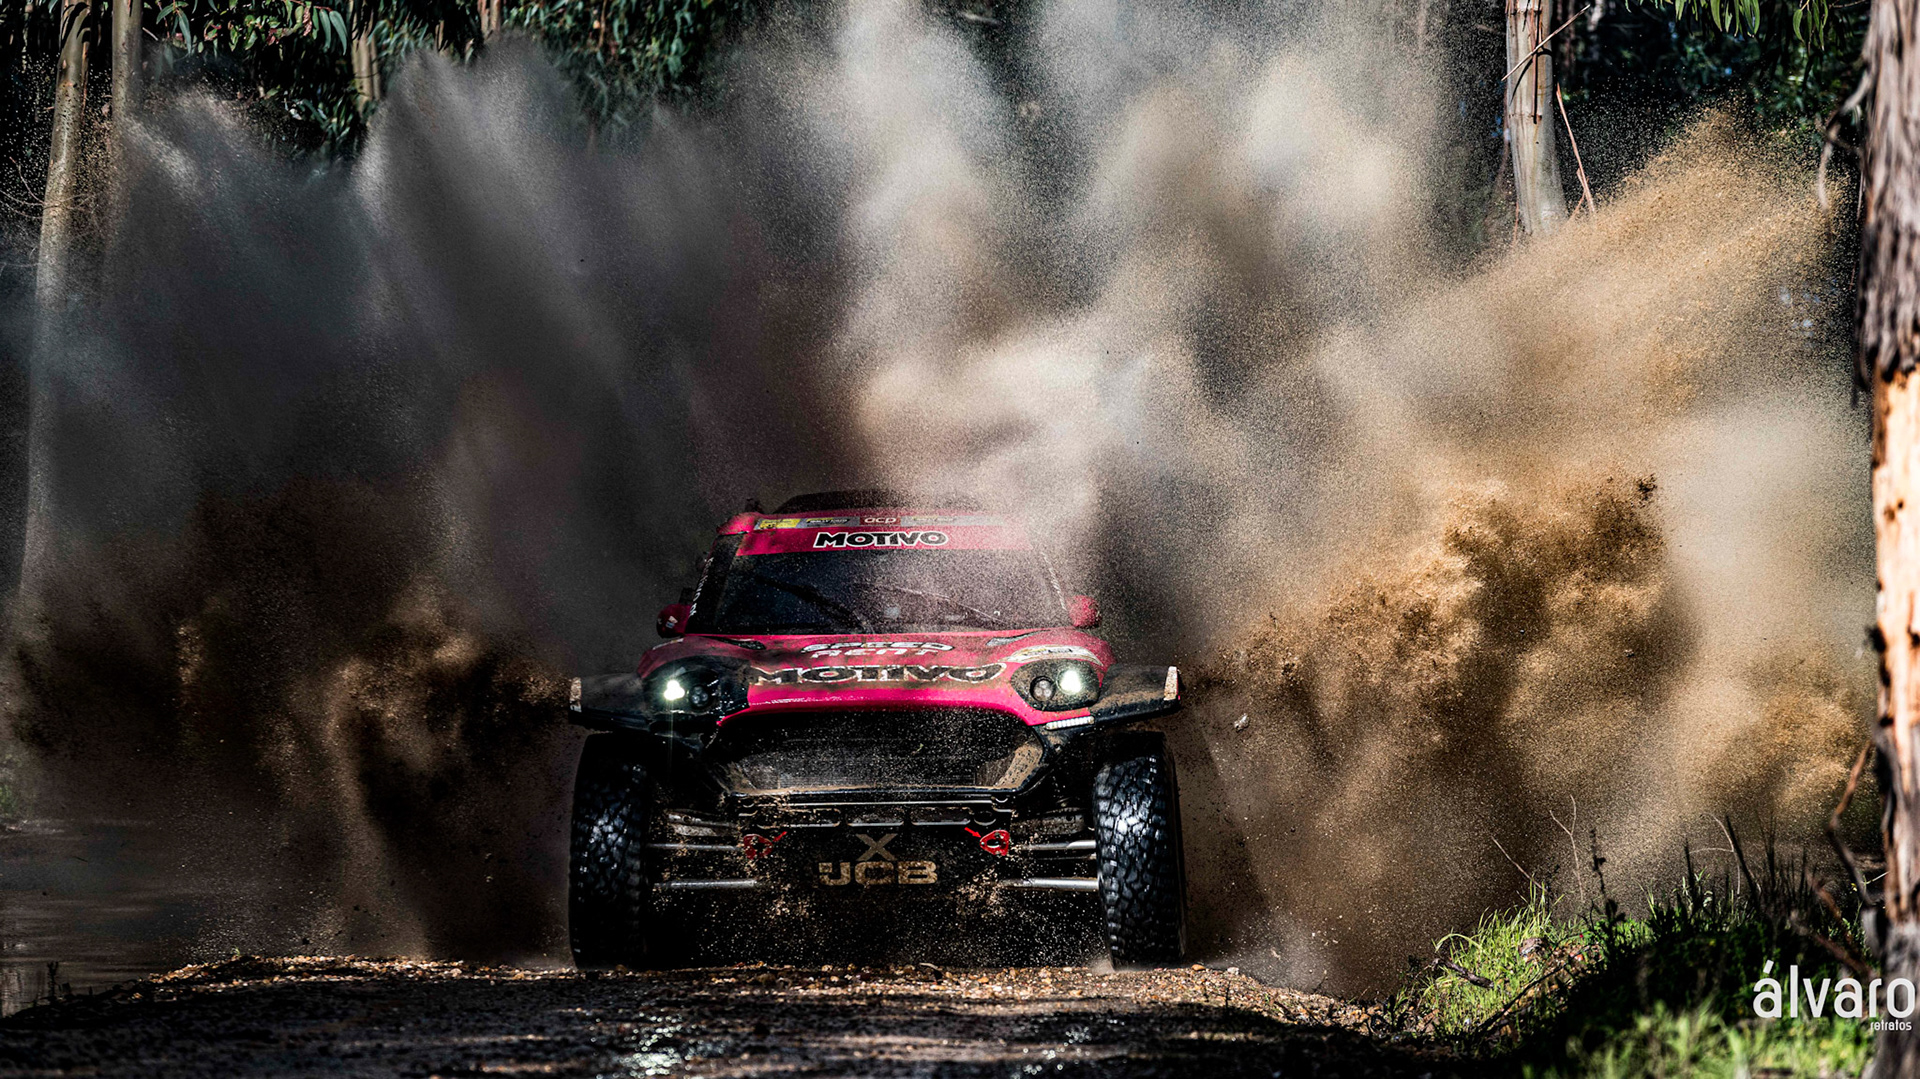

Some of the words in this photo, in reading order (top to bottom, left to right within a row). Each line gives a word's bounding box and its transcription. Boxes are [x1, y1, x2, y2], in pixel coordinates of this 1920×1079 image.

[864, 517, 897, 525] acp
[813, 531, 949, 548] MOTIVO
[748, 662, 1006, 685] MOTIVO
[818, 861, 938, 886] JCB
